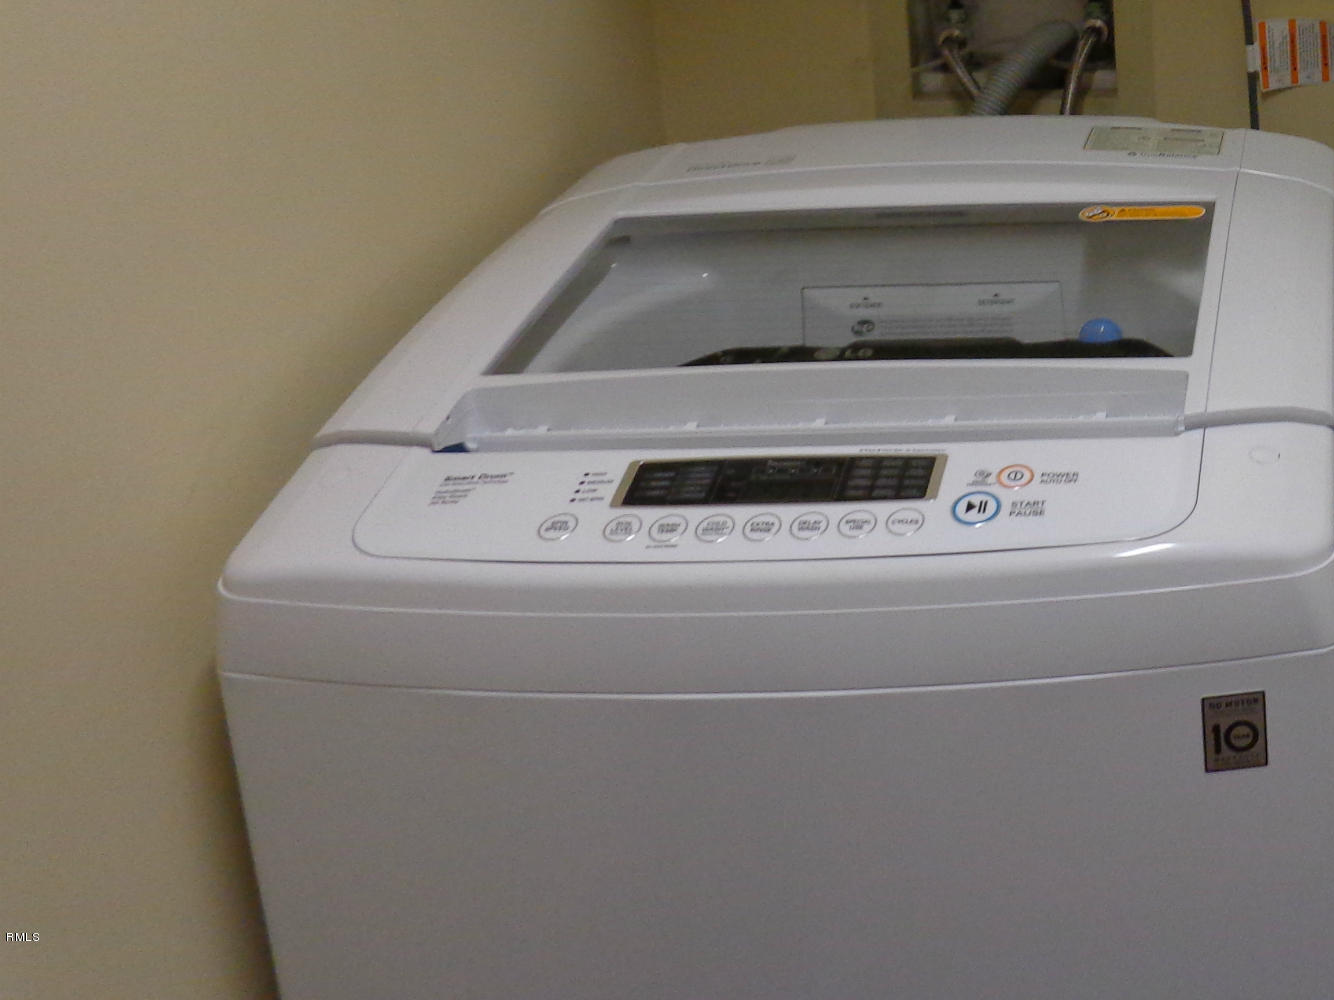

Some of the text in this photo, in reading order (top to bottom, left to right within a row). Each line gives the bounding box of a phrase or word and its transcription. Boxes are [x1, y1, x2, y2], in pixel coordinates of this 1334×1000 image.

[1040, 471, 1079, 479] POWER
[1010, 500, 1047, 508] START
[1008, 509, 1045, 517] PAUSE
[1211, 720, 1260, 756] 10
